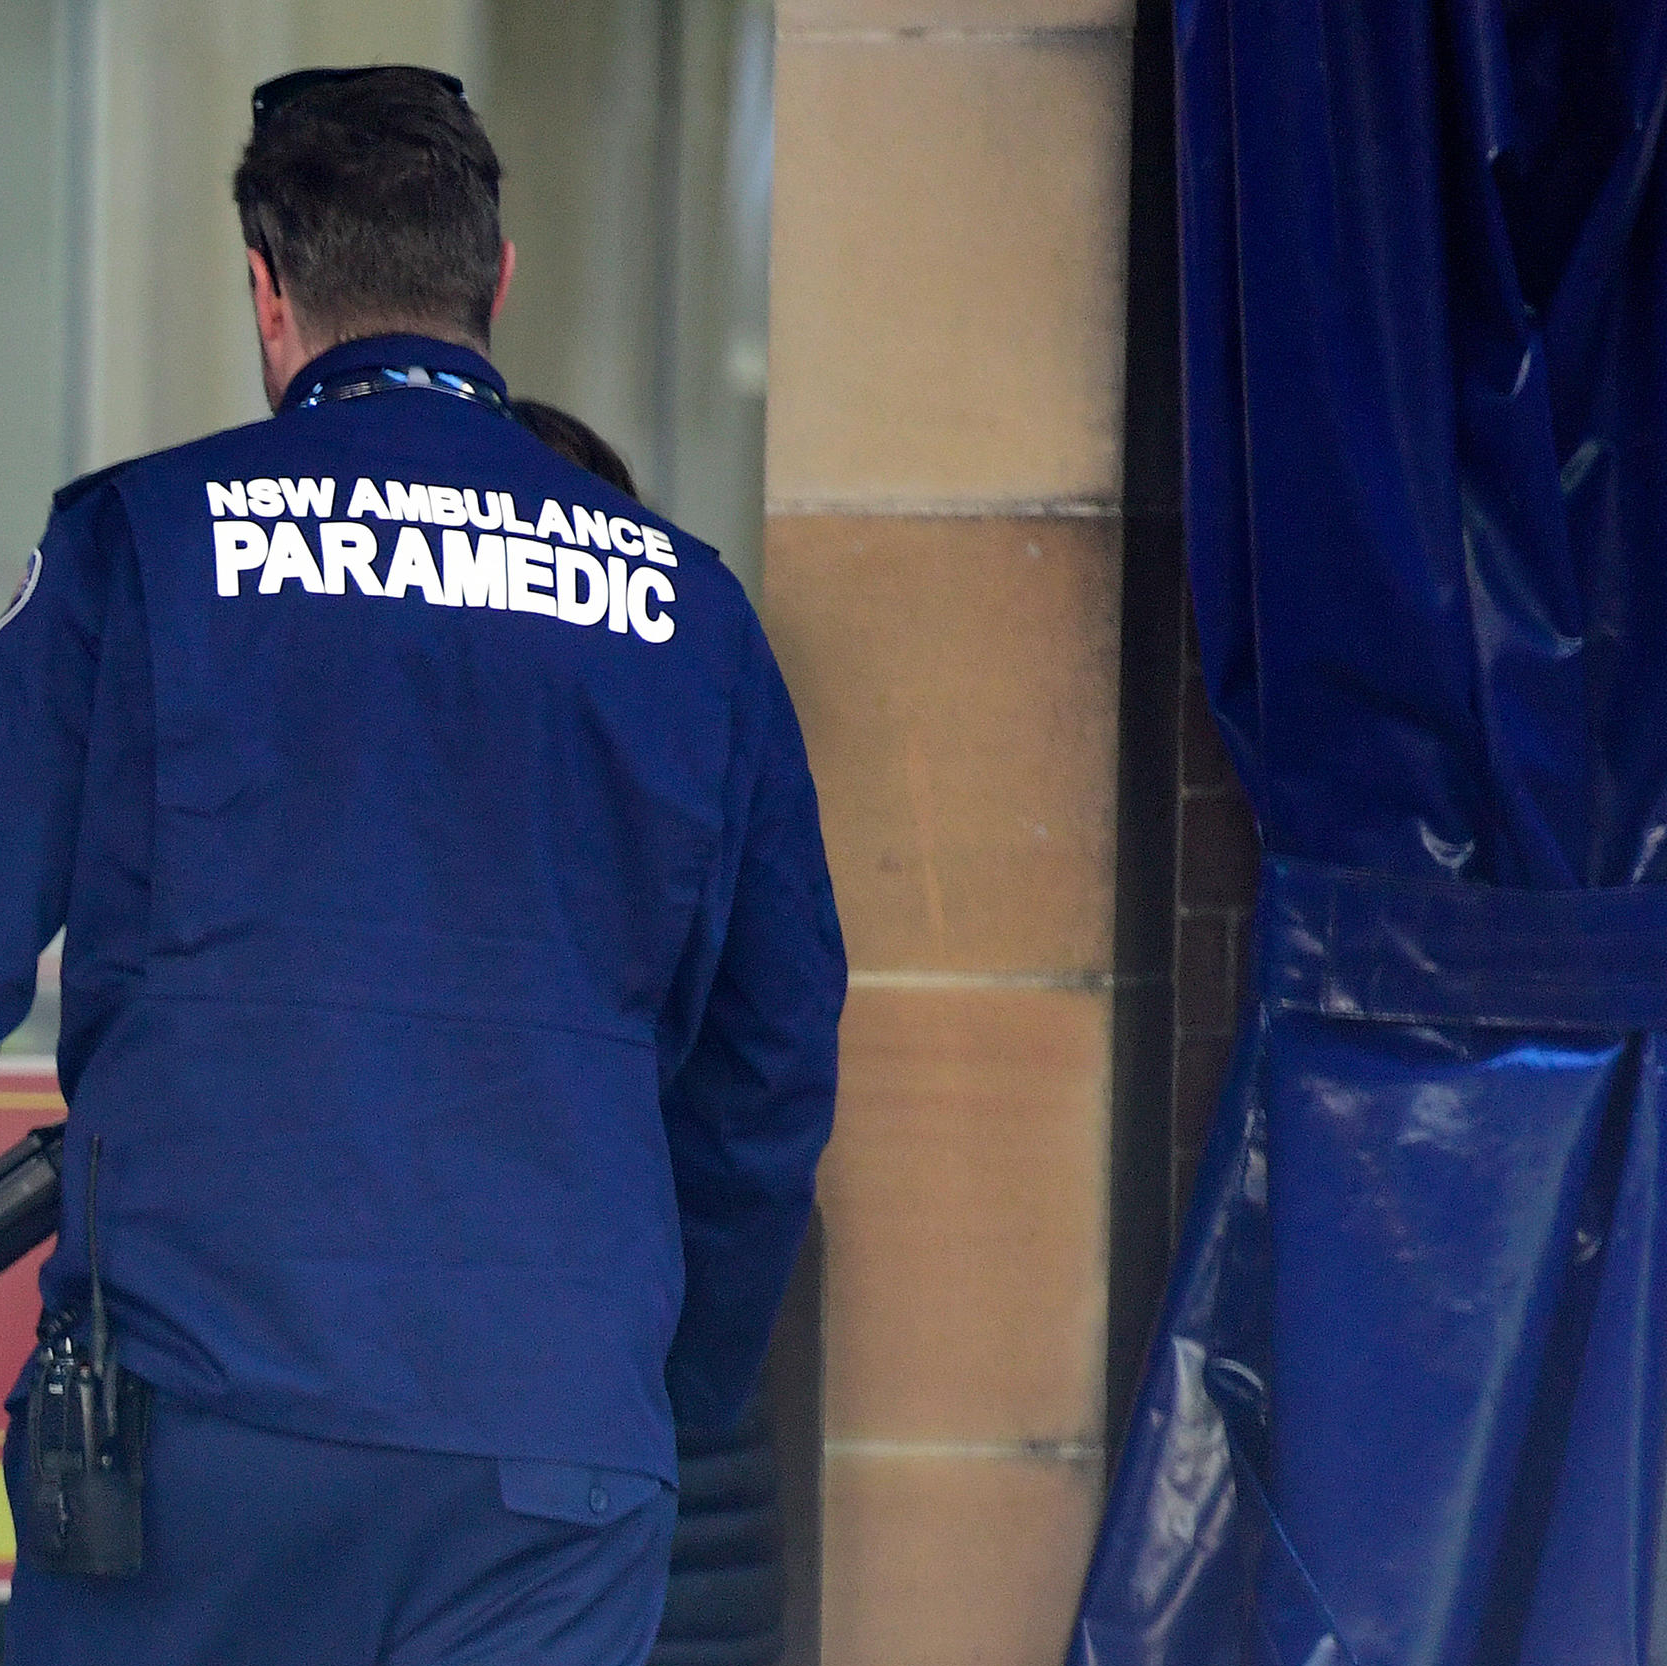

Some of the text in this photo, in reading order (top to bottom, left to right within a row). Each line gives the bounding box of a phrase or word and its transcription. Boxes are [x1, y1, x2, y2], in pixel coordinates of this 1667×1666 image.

[206, 476, 678, 568] NSW AMBULANCE
[213, 520, 677, 643] PARAMEDIC
